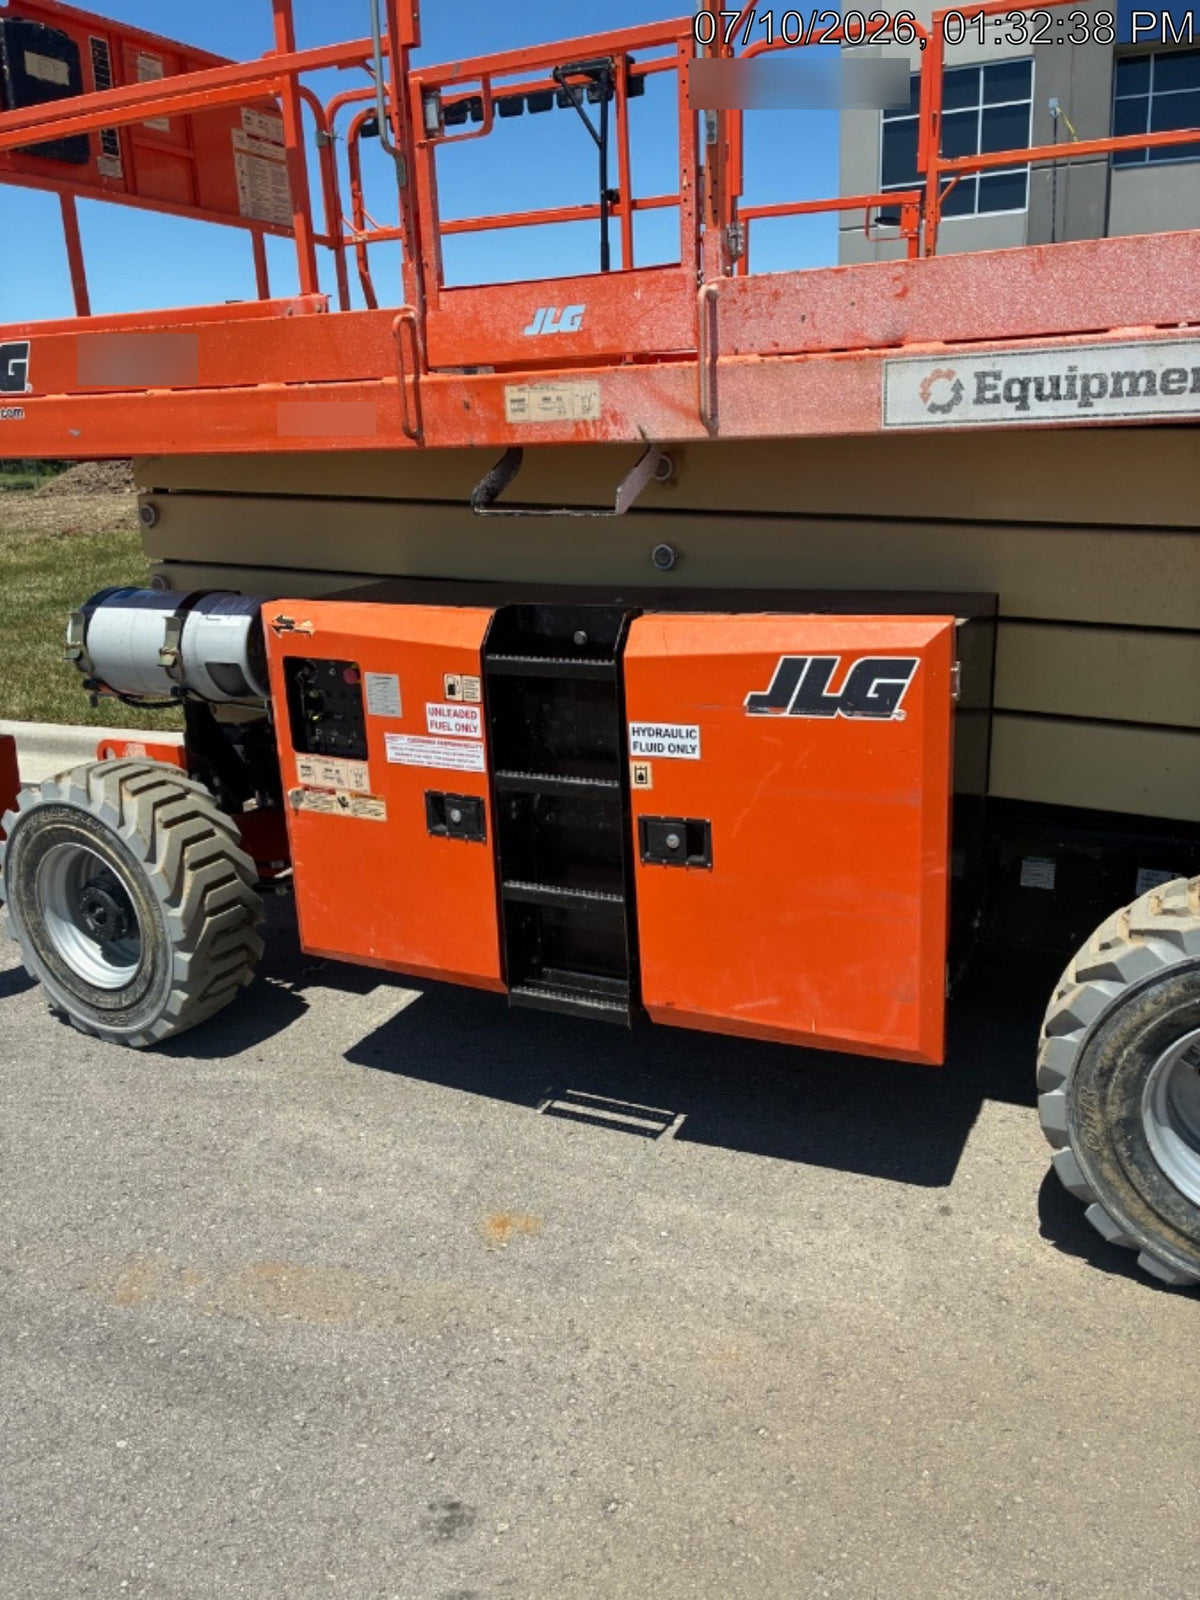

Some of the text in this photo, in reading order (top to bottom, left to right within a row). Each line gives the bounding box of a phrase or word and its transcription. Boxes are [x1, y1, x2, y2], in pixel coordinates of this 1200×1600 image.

[522, 303, 586, 336] JLG
[743, 655, 920, 721] JLG
[428, 706, 478, 720] UNLEADED
[429, 721, 479, 733] FUEL ONLY
[631, 726, 698, 740] HYDRAULIC
[632, 741, 698, 755] FLUID ONLY
